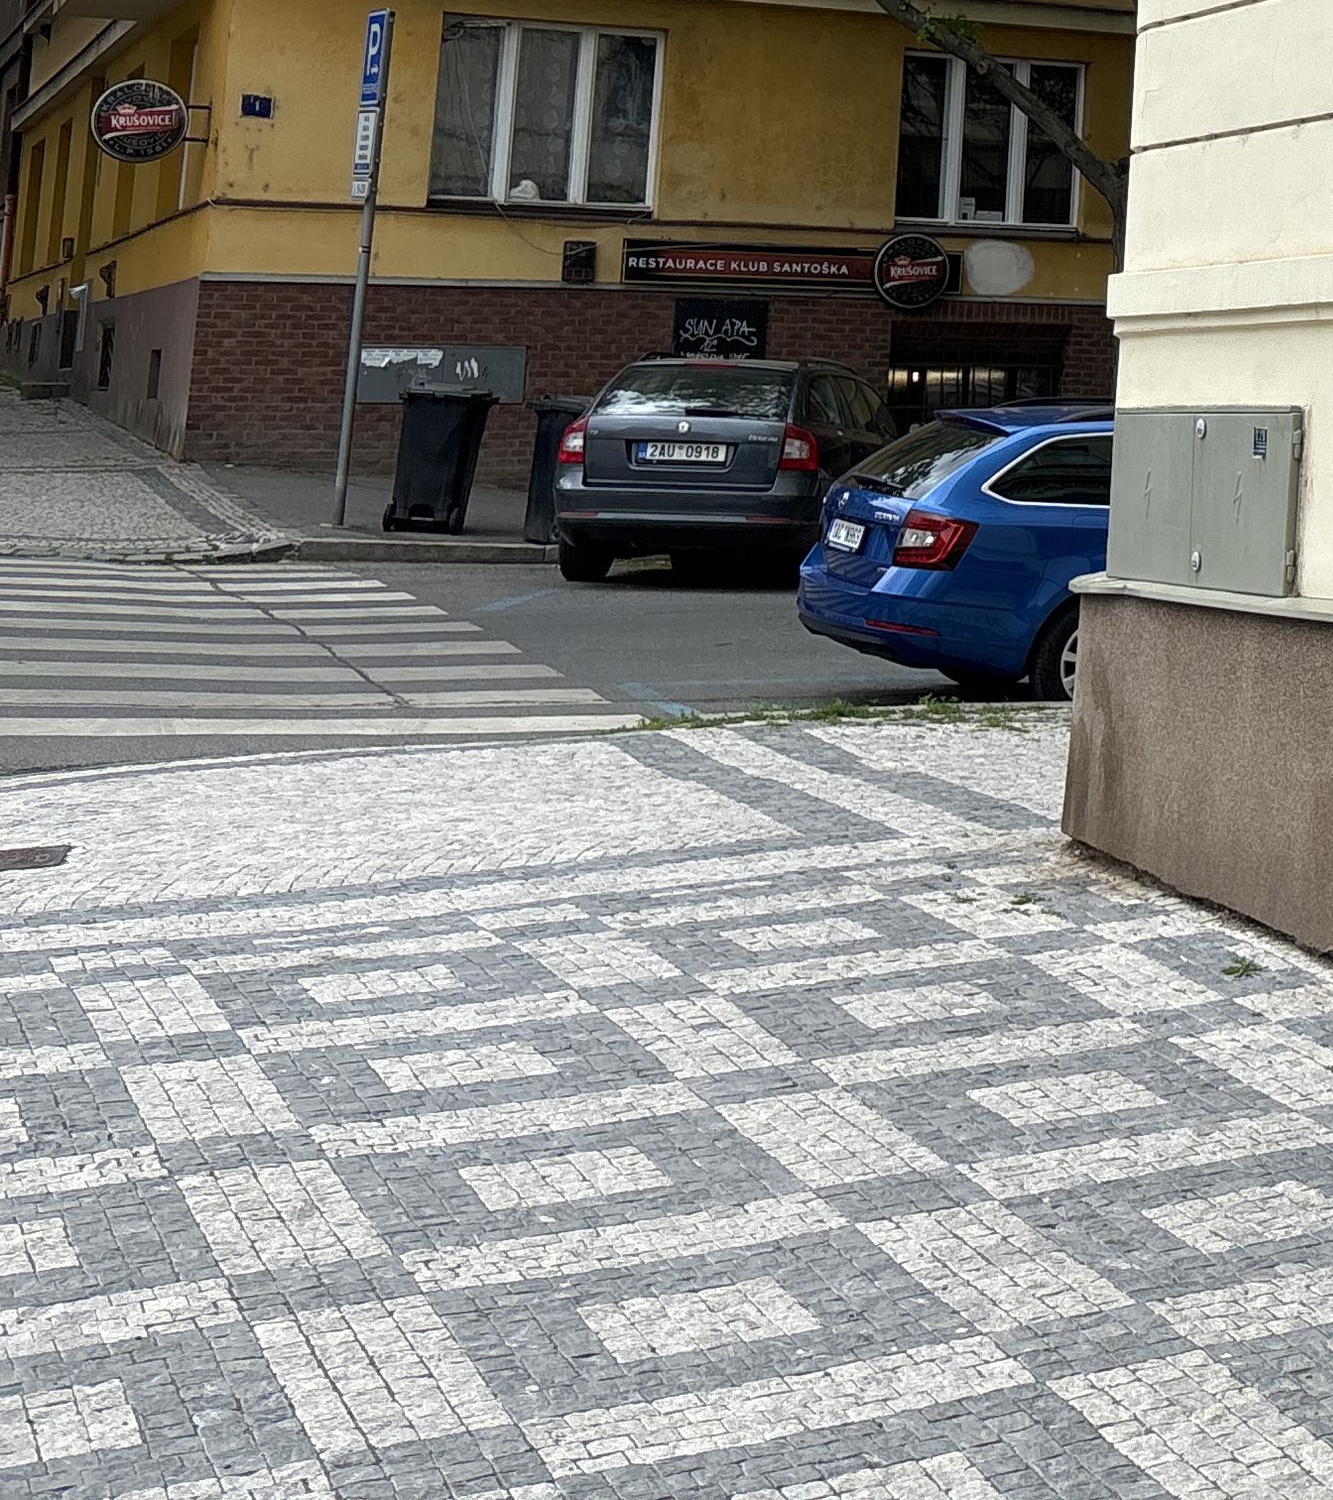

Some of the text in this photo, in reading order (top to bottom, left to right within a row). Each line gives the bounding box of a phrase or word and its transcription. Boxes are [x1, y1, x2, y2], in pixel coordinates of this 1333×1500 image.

[366, 22, 381, 76] P
[110, 113, 172, 130] KRUŠOVICE
[628, 256, 849, 275] RESTAURACE KLUB SANTOŠKA
[889, 265, 939, 280] KRUŠOVICE
[684, 317, 757, 337] SUN APA
[649, 443, 676, 458] 2AU
[685, 444, 720, 459] 0918
